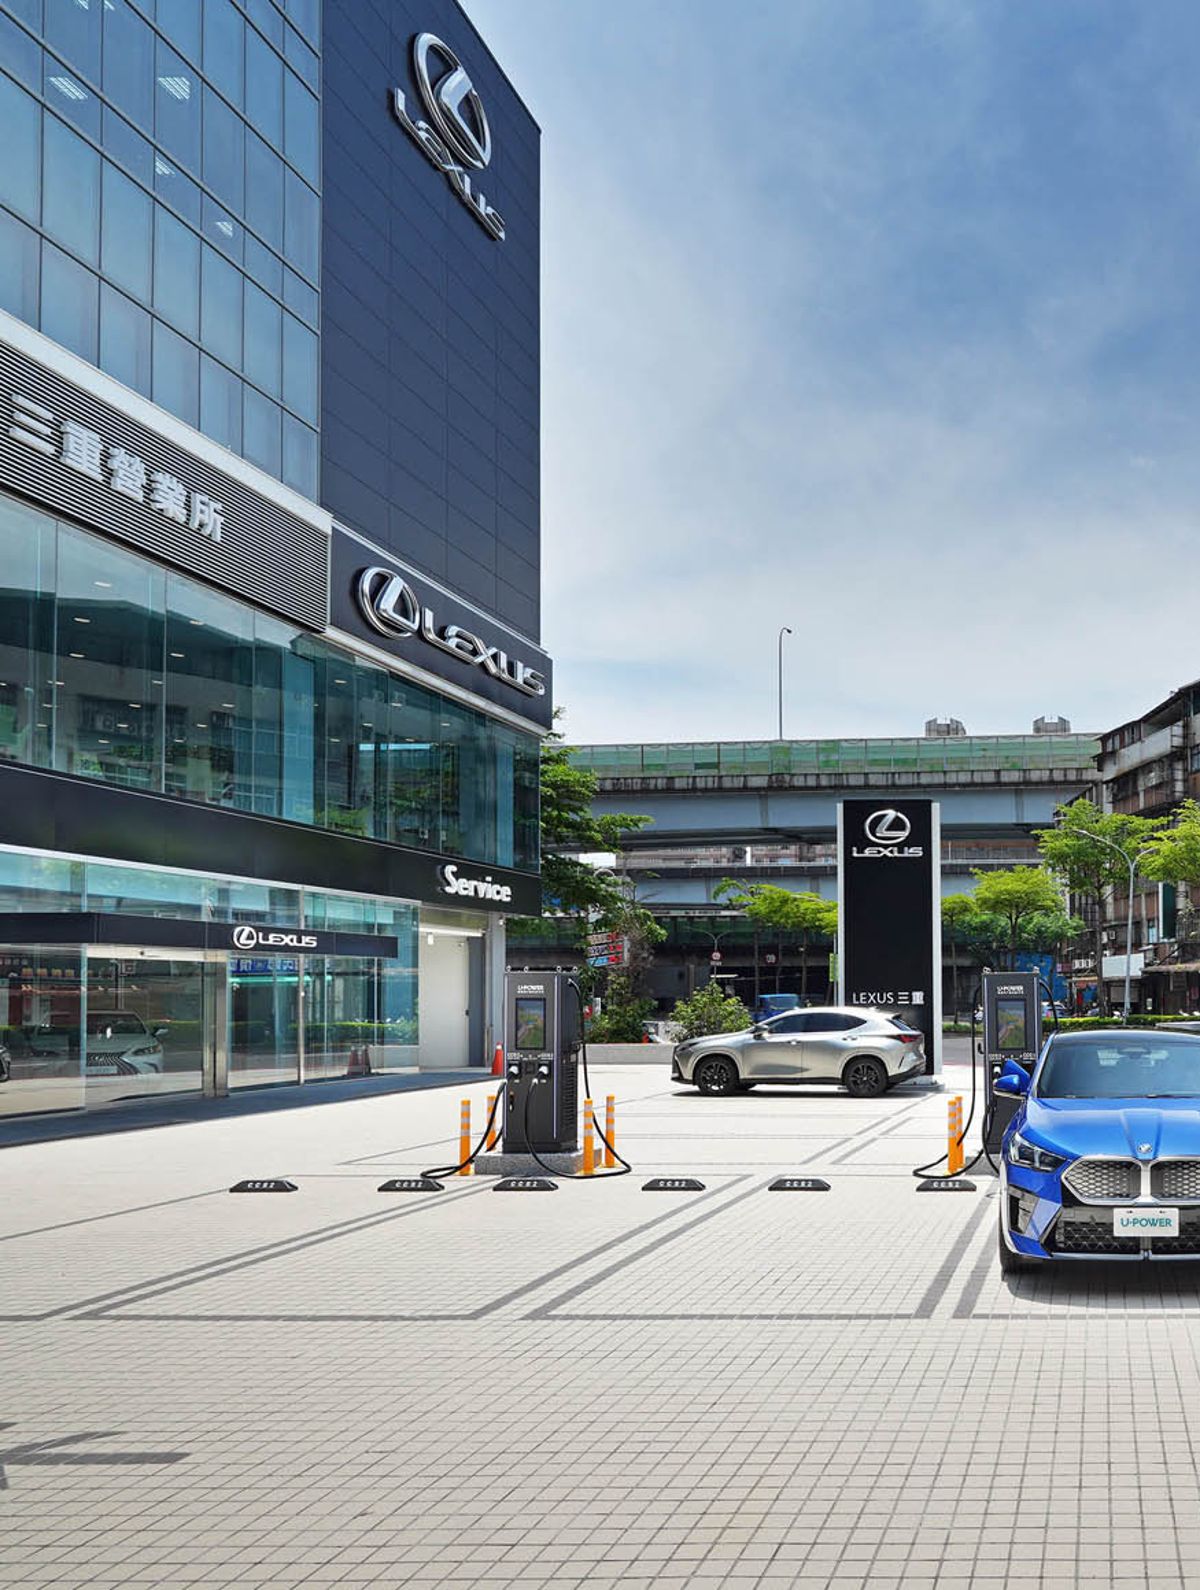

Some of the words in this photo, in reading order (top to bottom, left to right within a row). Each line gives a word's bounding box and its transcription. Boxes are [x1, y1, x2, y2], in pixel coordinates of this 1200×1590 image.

[394, 87, 505, 241] LEXUS
[8, 393, 224, 542] 三重營業所
[422, 606, 545, 696] LEXUS
[852, 847, 923, 857] LEXUS
[444, 864, 512, 902] Service
[258, 931, 317, 948] LEXUS
[852, 992, 894, 1005] LEXUS
[897, 991, 924, 1005] 三重
[247, 1181, 276, 1189] CCS2
[395, 1181, 424, 1189] CCS2
[510, 1181, 539, 1189] CCS2
[658, 1180, 687, 1188] CCS2
[785, 1180, 814, 1188] CCS2
[1120, 1218, 1172, 1228] U-POWER
